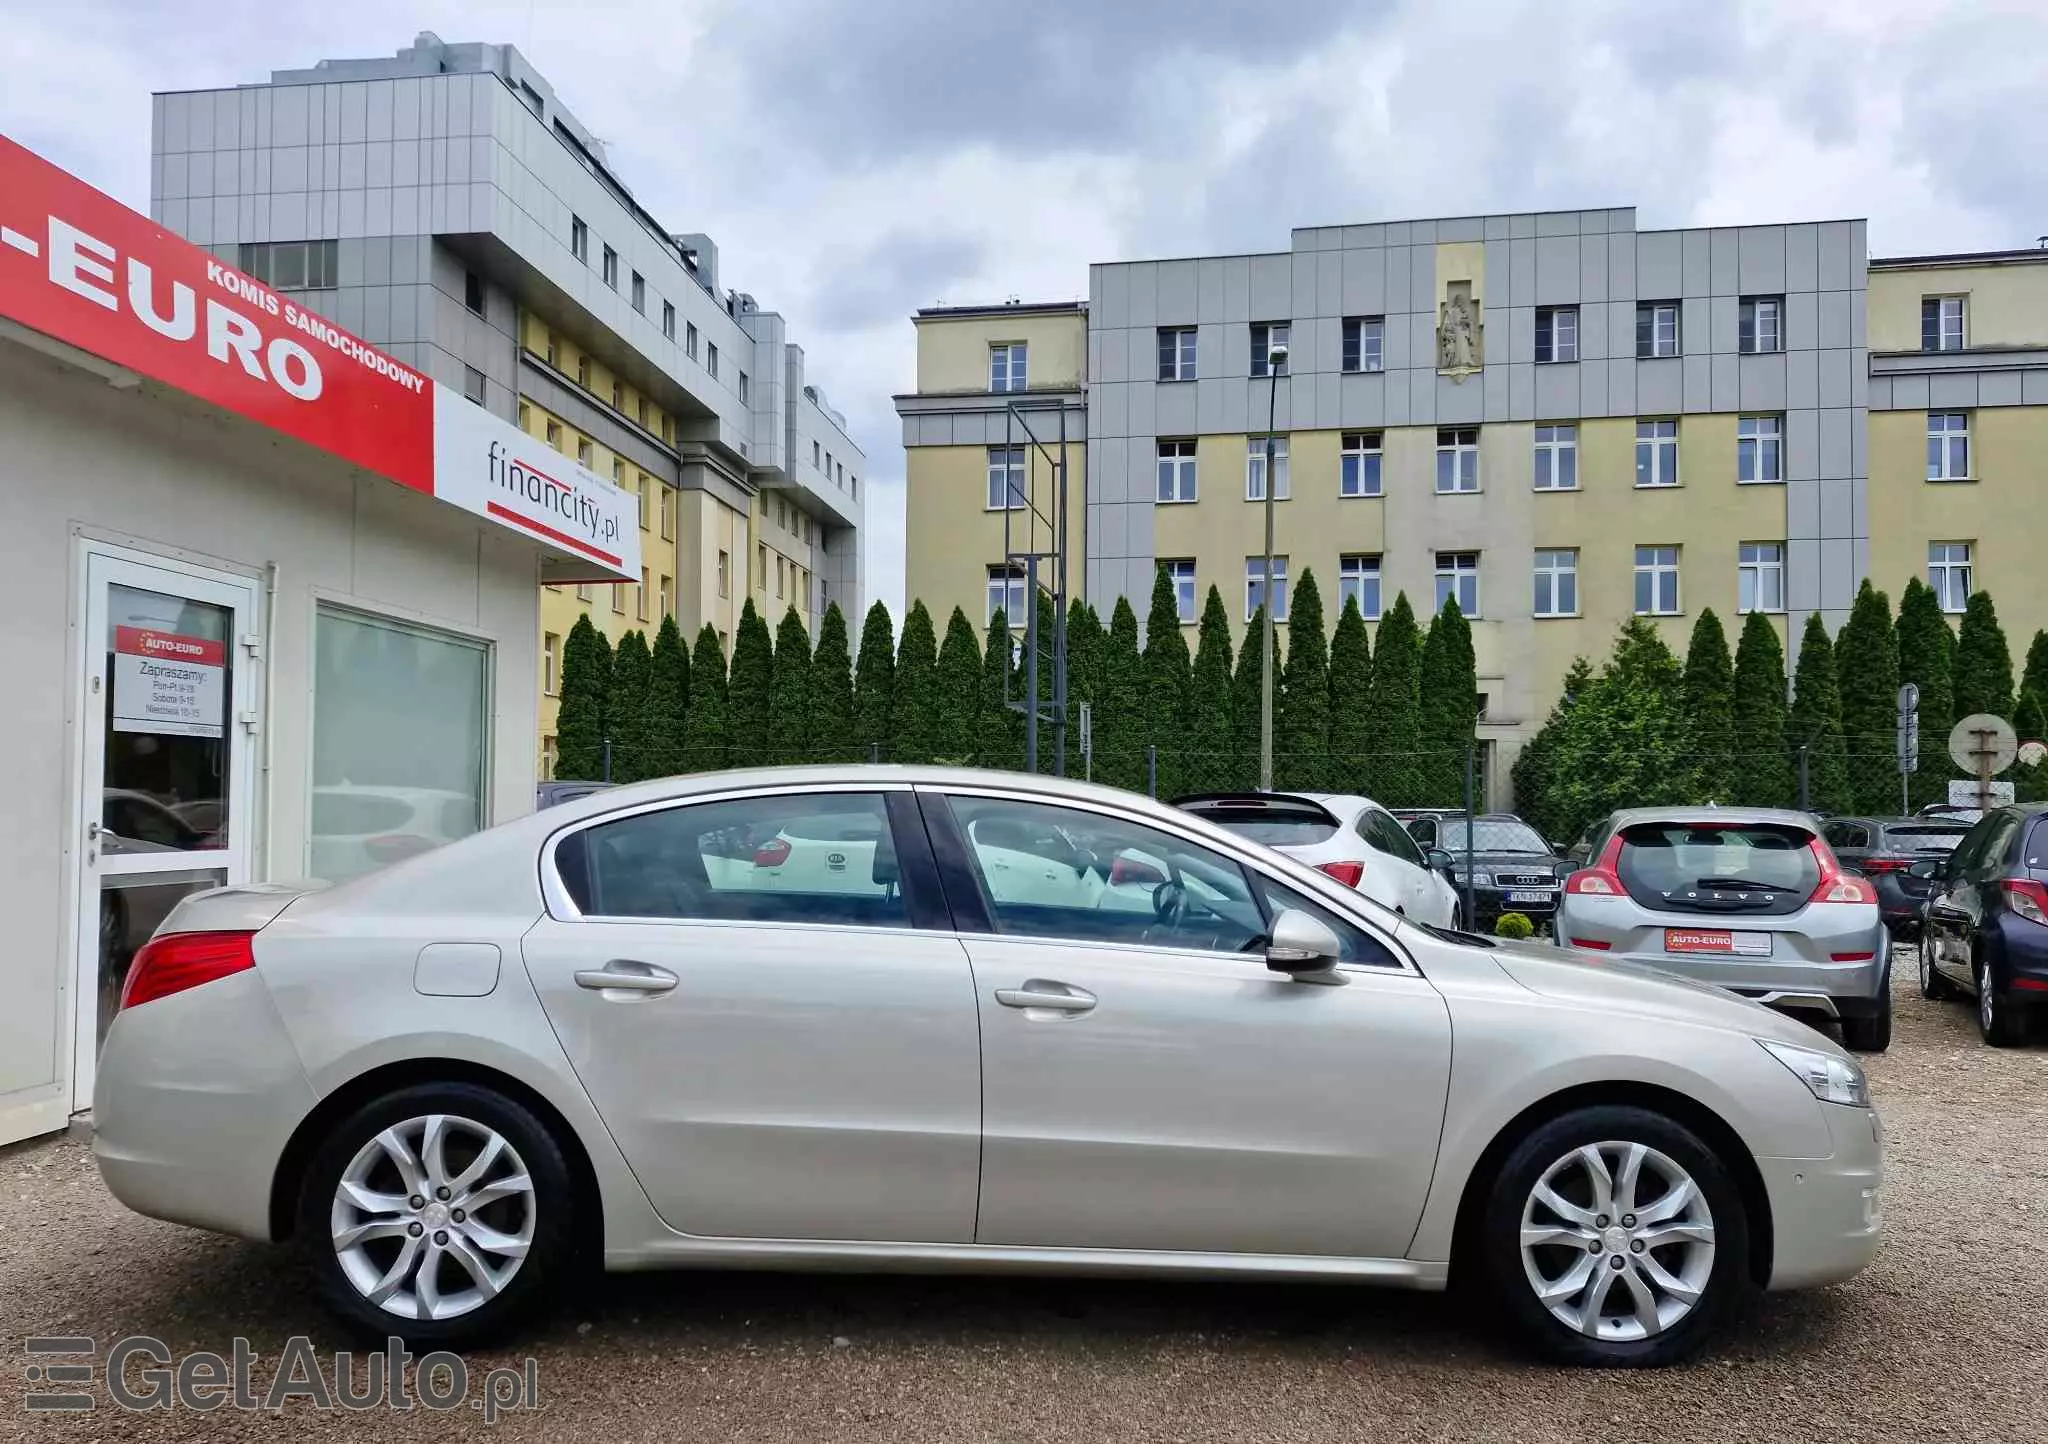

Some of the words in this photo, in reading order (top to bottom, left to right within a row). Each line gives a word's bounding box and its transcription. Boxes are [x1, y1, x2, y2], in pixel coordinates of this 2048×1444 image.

[207, 260, 279, 315] KOMIS
[284, 304, 424, 394] SAMOCHODOWY
[488, 441, 619, 543] financity.pl
[146, 638, 204, 656] AUTO-EURO
[1661, 891, 1775, 901] VOLVO
[1672, 934, 1731, 945] AUTO-EURO
